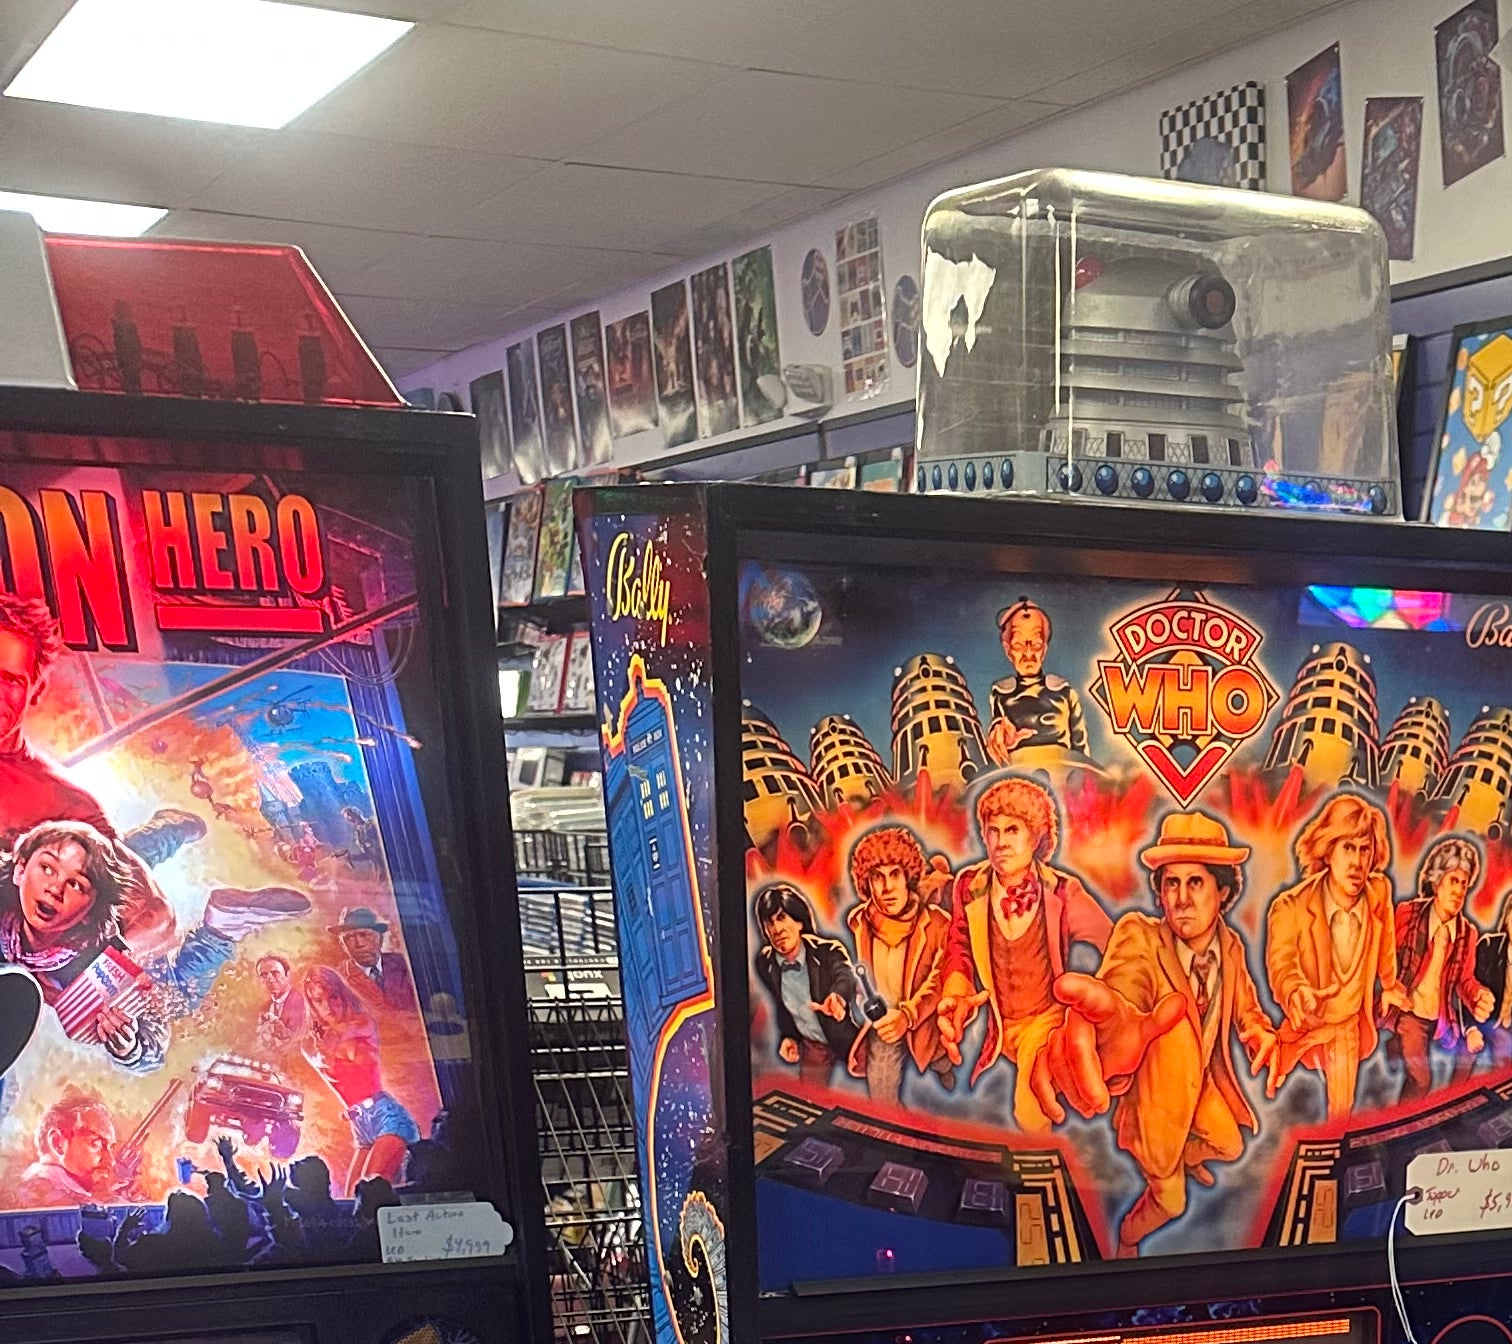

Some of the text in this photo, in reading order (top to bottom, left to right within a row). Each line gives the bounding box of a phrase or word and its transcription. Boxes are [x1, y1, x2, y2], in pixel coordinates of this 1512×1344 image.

[145, 490, 330, 598] HERO
[607, 532, 674, 646] Bally
[1122, 608, 1249, 663] DOCTOR
[1098, 661, 1268, 739] WHO
[102, 958, 127, 984] FRESH
[1436, 1153, 1501, 1177] Dr. Who
